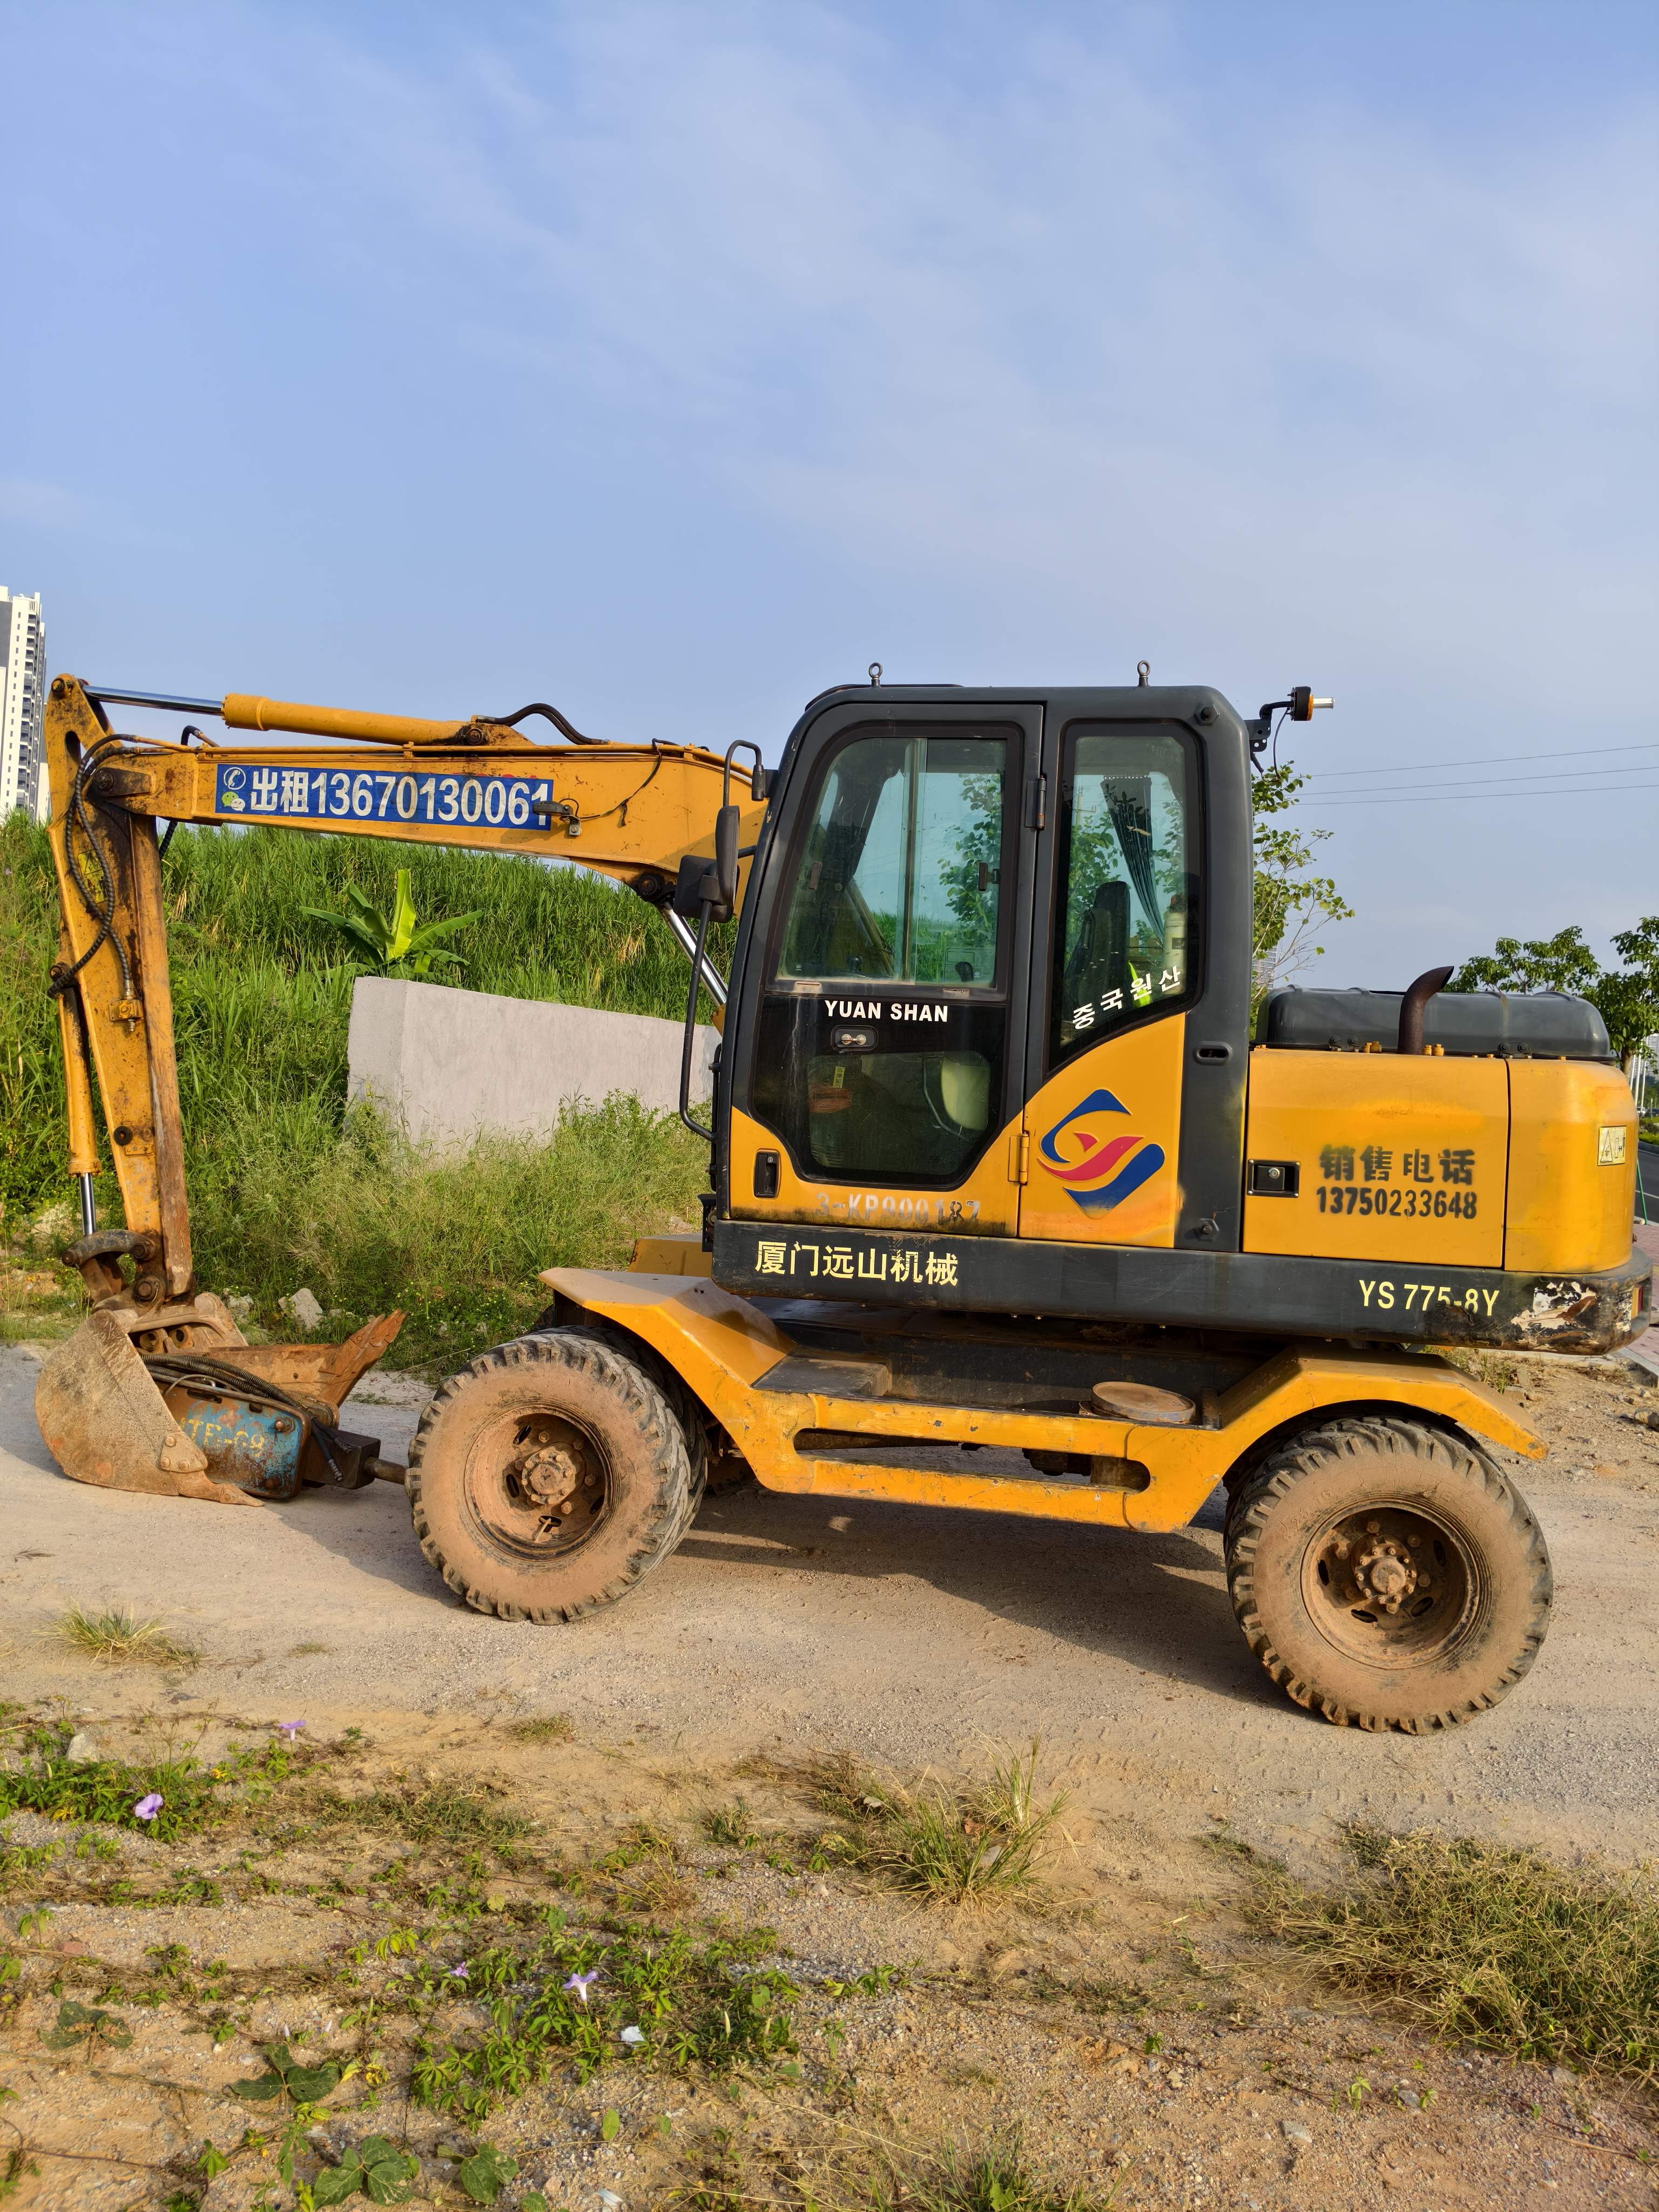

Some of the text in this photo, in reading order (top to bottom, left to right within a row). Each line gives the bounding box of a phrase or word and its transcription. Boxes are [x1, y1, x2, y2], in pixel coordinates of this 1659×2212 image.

[824, 1000, 948, 1022] YUAN SHAN
[1318, 1144, 1476, 1185] 销售电话
[1317, 1186, 1478, 1219] 13750233648
[755, 1240, 959, 1286] 厦门远山机械
[1359, 1279, 1395, 1310] YS
